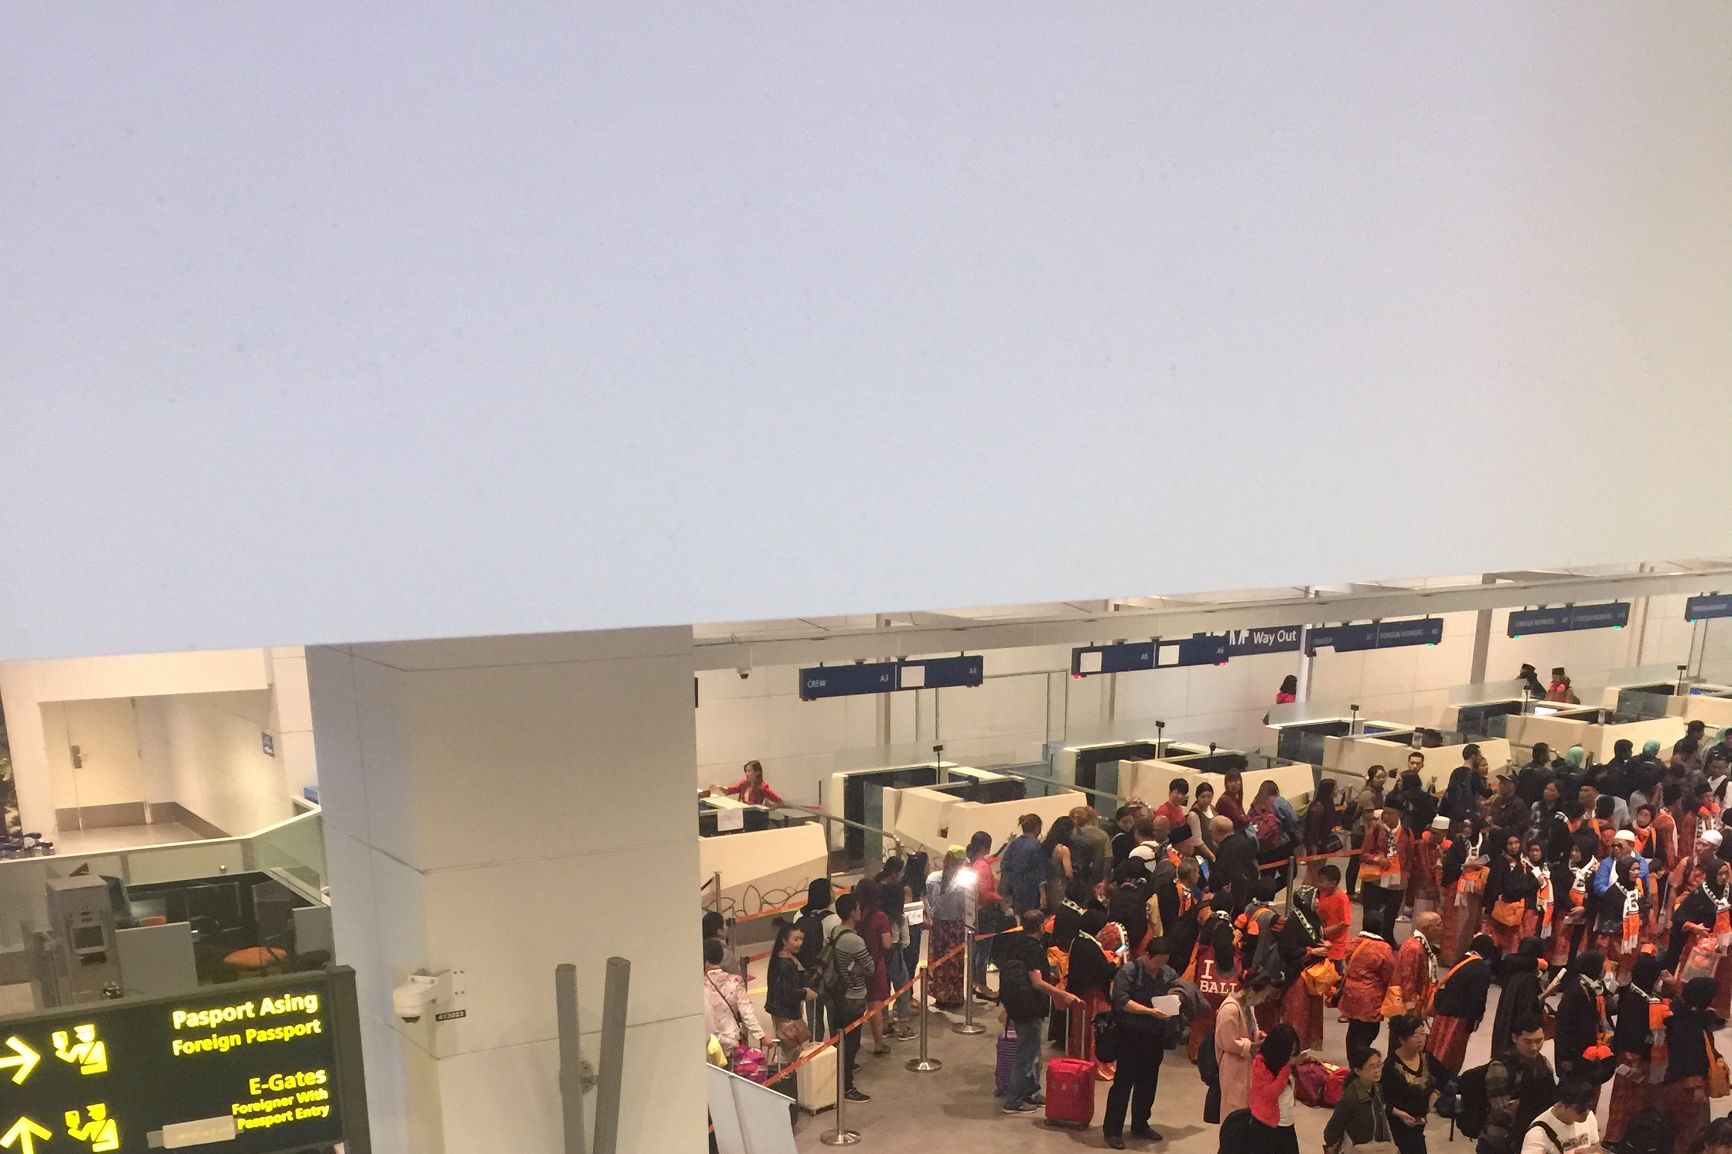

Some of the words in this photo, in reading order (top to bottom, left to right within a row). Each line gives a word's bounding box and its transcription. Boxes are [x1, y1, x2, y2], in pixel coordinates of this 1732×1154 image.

[1253, 631, 1276, 646] Way
[1277, 629, 1297, 643] Out
[807, 679, 827, 689] CREW
[880, 673, 889, 682] A3
[969, 667, 977, 675] A4
[1201, 959, 1215, 980] I
[1199, 980, 1238, 994] BALI
[172, 1001, 255, 1029] Pasport
[259, 993, 319, 1016] Asing
[172, 1033, 242, 1056] Foreign
[245, 1019, 322, 1044] Passport
[249, 1069, 327, 1096] E-Gates
[231, 1095, 294, 1116] Foreigner
[296, 1088, 329, 1104] With
[237, 1110, 293, 1130] Passport
[295, 1104, 330, 1120] Entry
